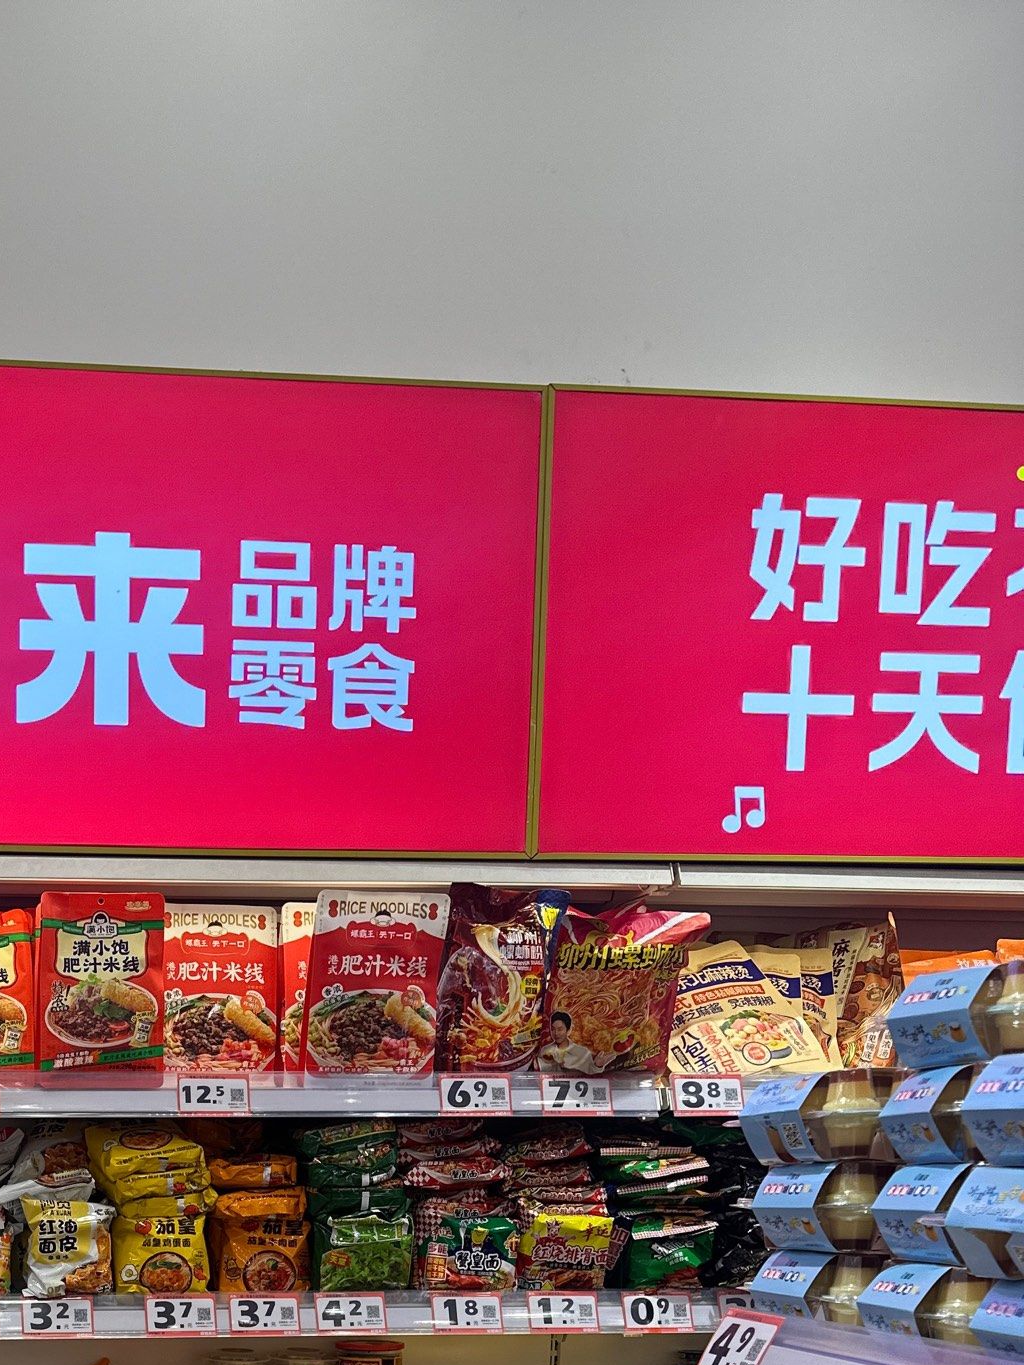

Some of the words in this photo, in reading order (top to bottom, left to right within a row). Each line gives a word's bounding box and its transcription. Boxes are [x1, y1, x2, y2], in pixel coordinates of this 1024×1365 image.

[230, 540, 416, 637] 品牌
[228, 640, 415, 734] 零食
[173, 914, 199, 926] RICE
[202, 913, 257, 928] NOODLES
[340, 901, 366, 916] RICE
[370, 902, 427, 920] NOODLES
[72, 940, 130, 956] 满小饱
[63, 956, 139, 973] 肥汁米线
[177, 961, 265, 984] 肥汁米线
[340, 955, 428, 977] 肥汁米线
[182, 1086, 225, 1104] 12.5
[447, 1080, 487, 1108] 6.9
[549, 1080, 589, 1108] 7.9
[39, 1219, 78, 1236] 红油
[156, 1220, 197, 1235] 茄皇
[262, 1221, 305, 1236] 茄皇
[39, 1236, 78, 1254] 面皮
[455, 1250, 502, 1272] 蟹皇面
[30, 1303, 69, 1330] 3.2
[154, 1301, 192, 1329] 3.7
[238, 1300, 275, 1328] 3.7
[322, 1300, 362, 1327] 4.2
[444, 1299, 478, 1326] 1.8
[537, 1298, 575, 1325] 1.2
[631, 1298, 669, 1325] 0.9
